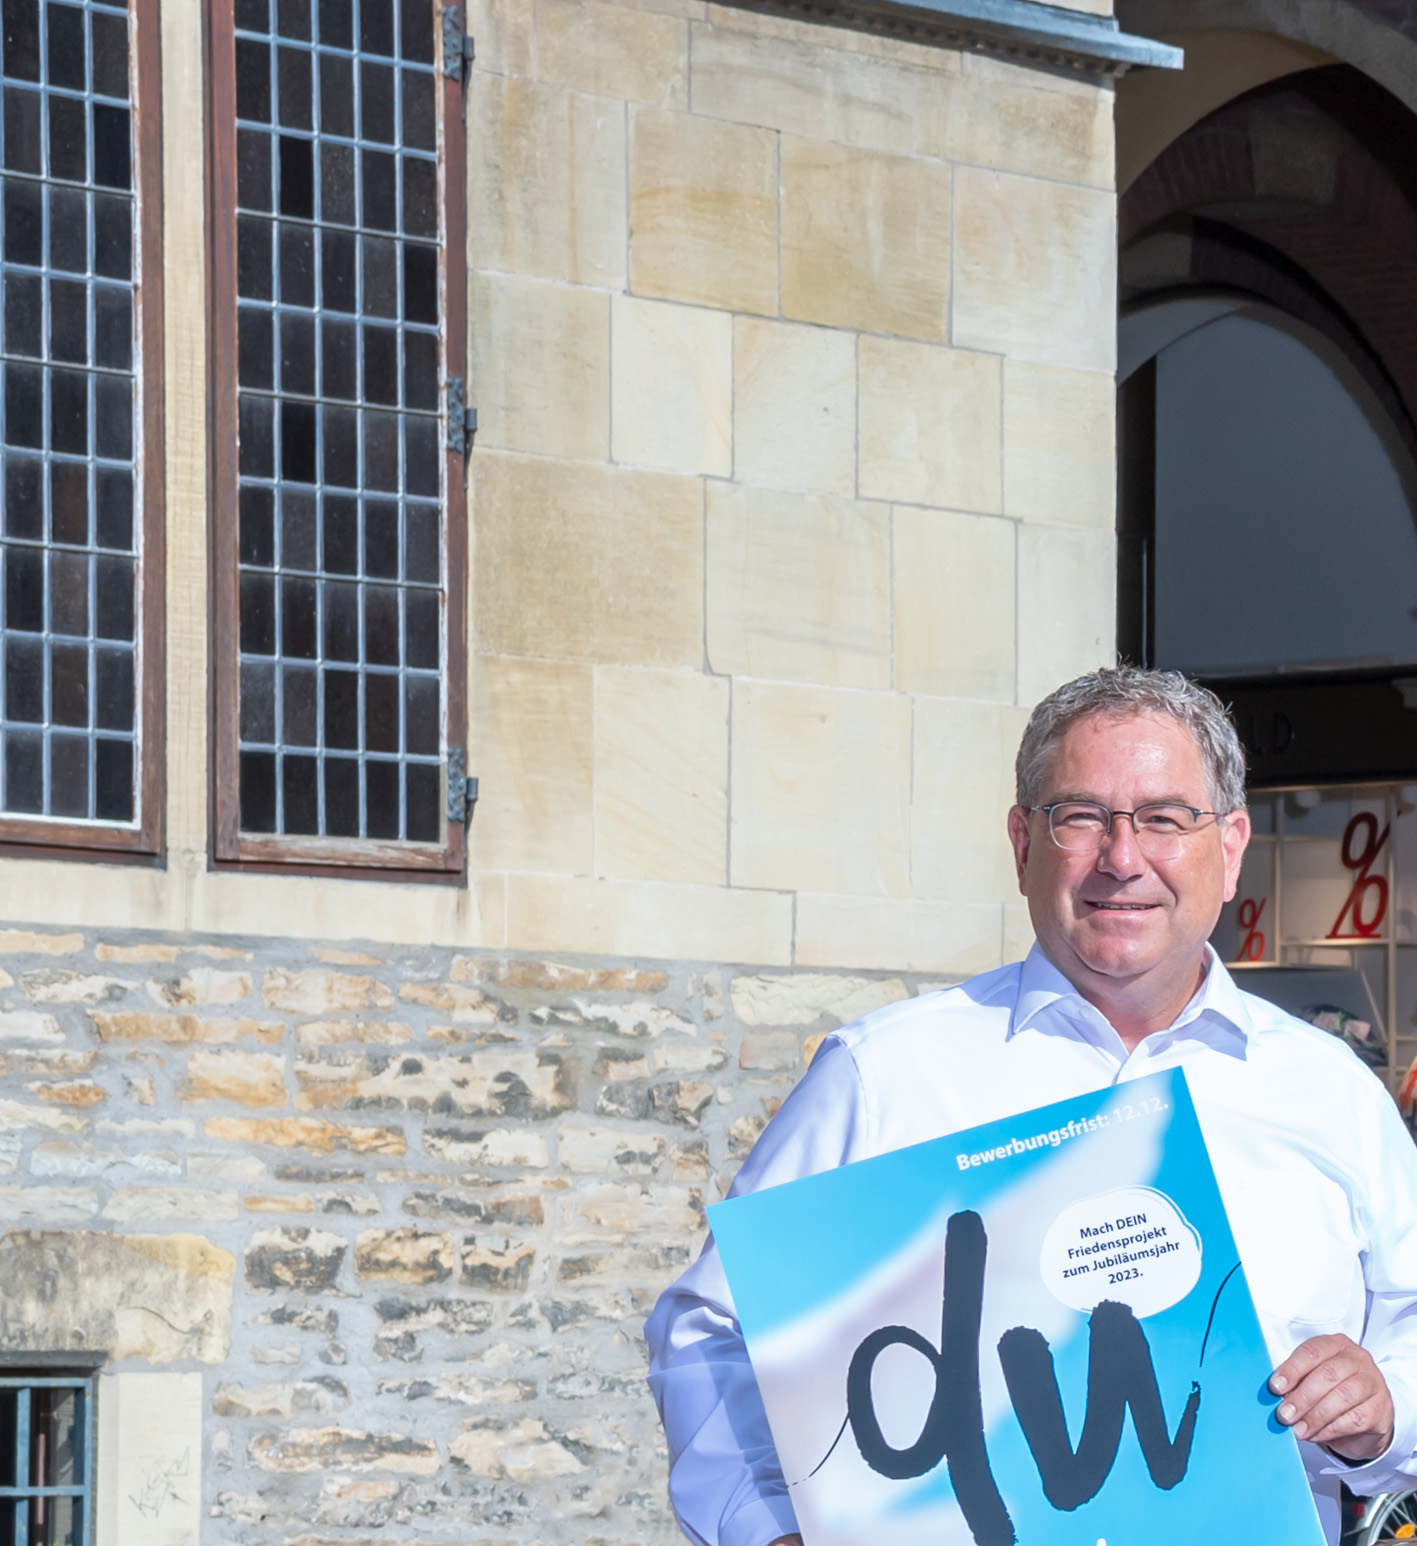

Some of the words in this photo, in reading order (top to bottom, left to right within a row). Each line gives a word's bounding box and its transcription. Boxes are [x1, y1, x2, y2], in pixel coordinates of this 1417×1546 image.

[956, 1115, 1110, 1171] Bewerbungsfrist:
[1112, 1096, 1169, 1124] 12.12.
[1067, 1226, 1168, 1260] Friedensprojekt
[1080, 1221, 1113, 1239] Mach
[1116, 1213, 1147, 1230] DEIN
[1062, 1264, 1090, 1279] zum
[1092, 1241, 1181, 1272] Jubiläumsjahr
[1107, 1267, 1144, 1285] 2023.
